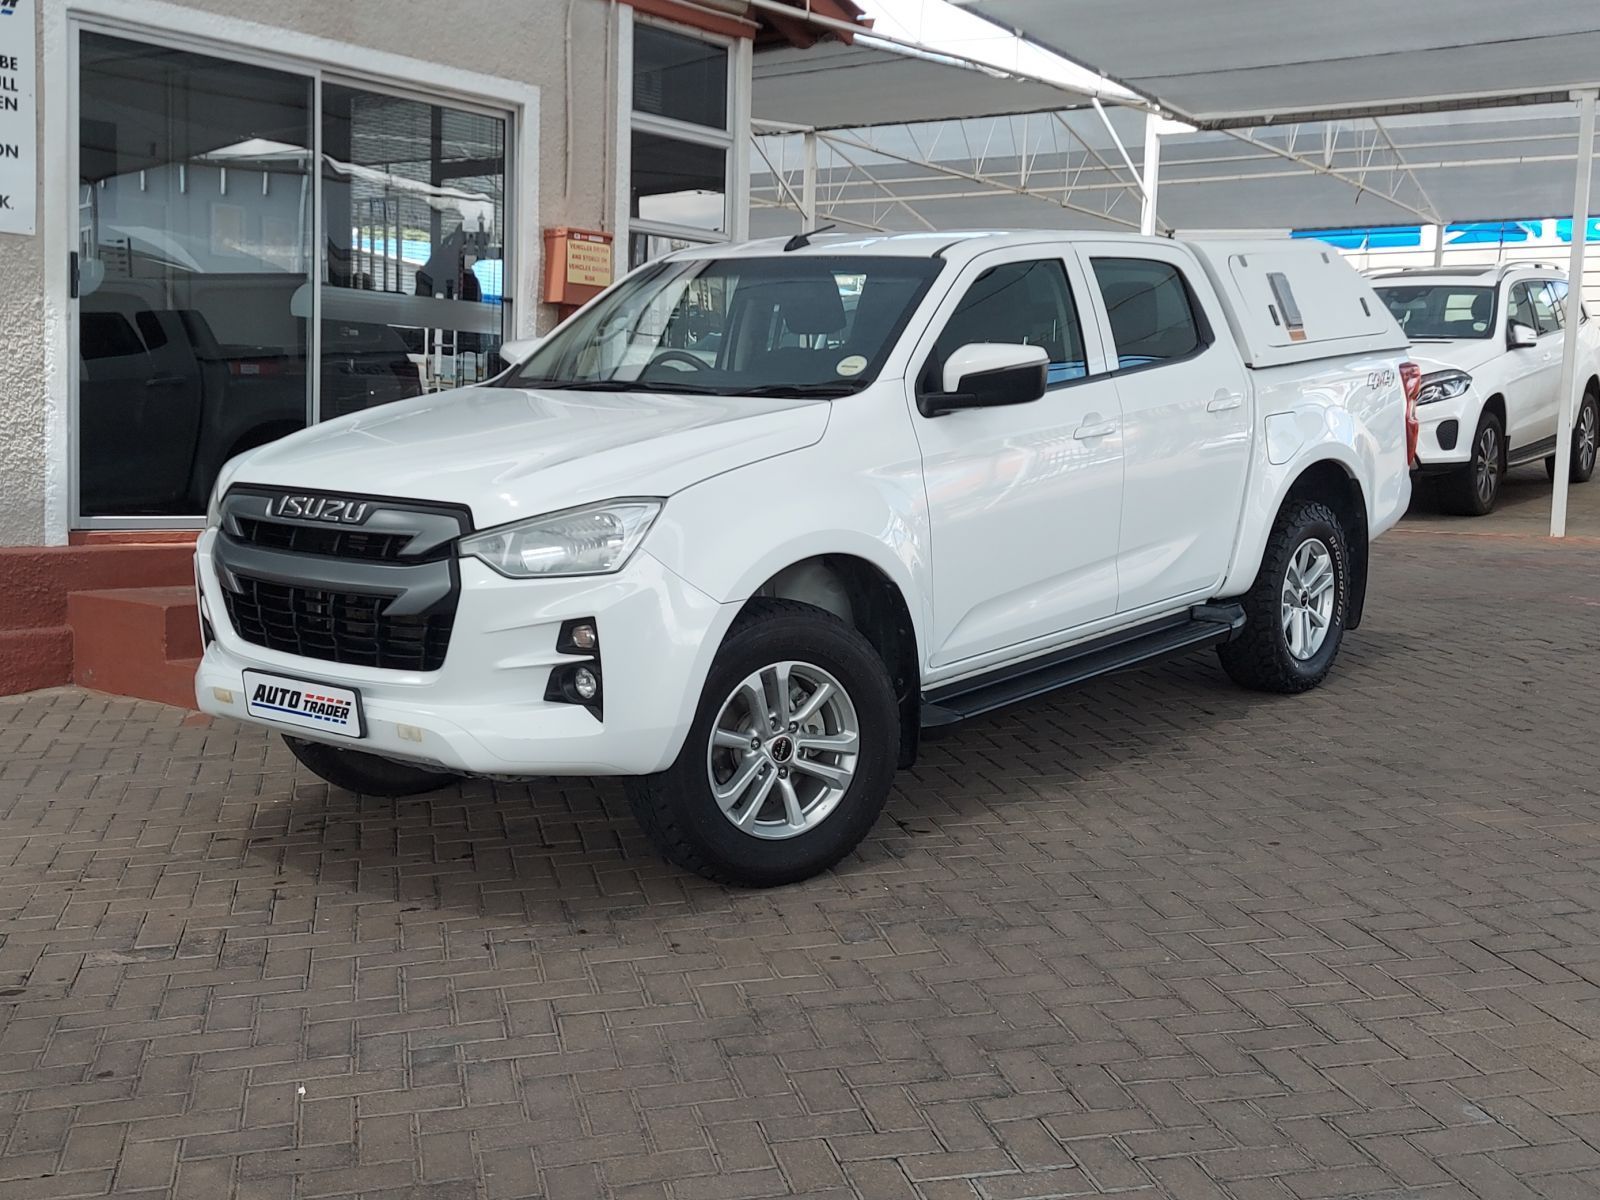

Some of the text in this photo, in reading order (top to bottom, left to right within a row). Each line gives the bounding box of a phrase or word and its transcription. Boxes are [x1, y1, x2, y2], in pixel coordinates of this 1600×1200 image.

[0, 76, 18, 92] LL
[278, 495, 367, 523] ISUZU
[253, 684, 350, 719] AUTO TRADER
